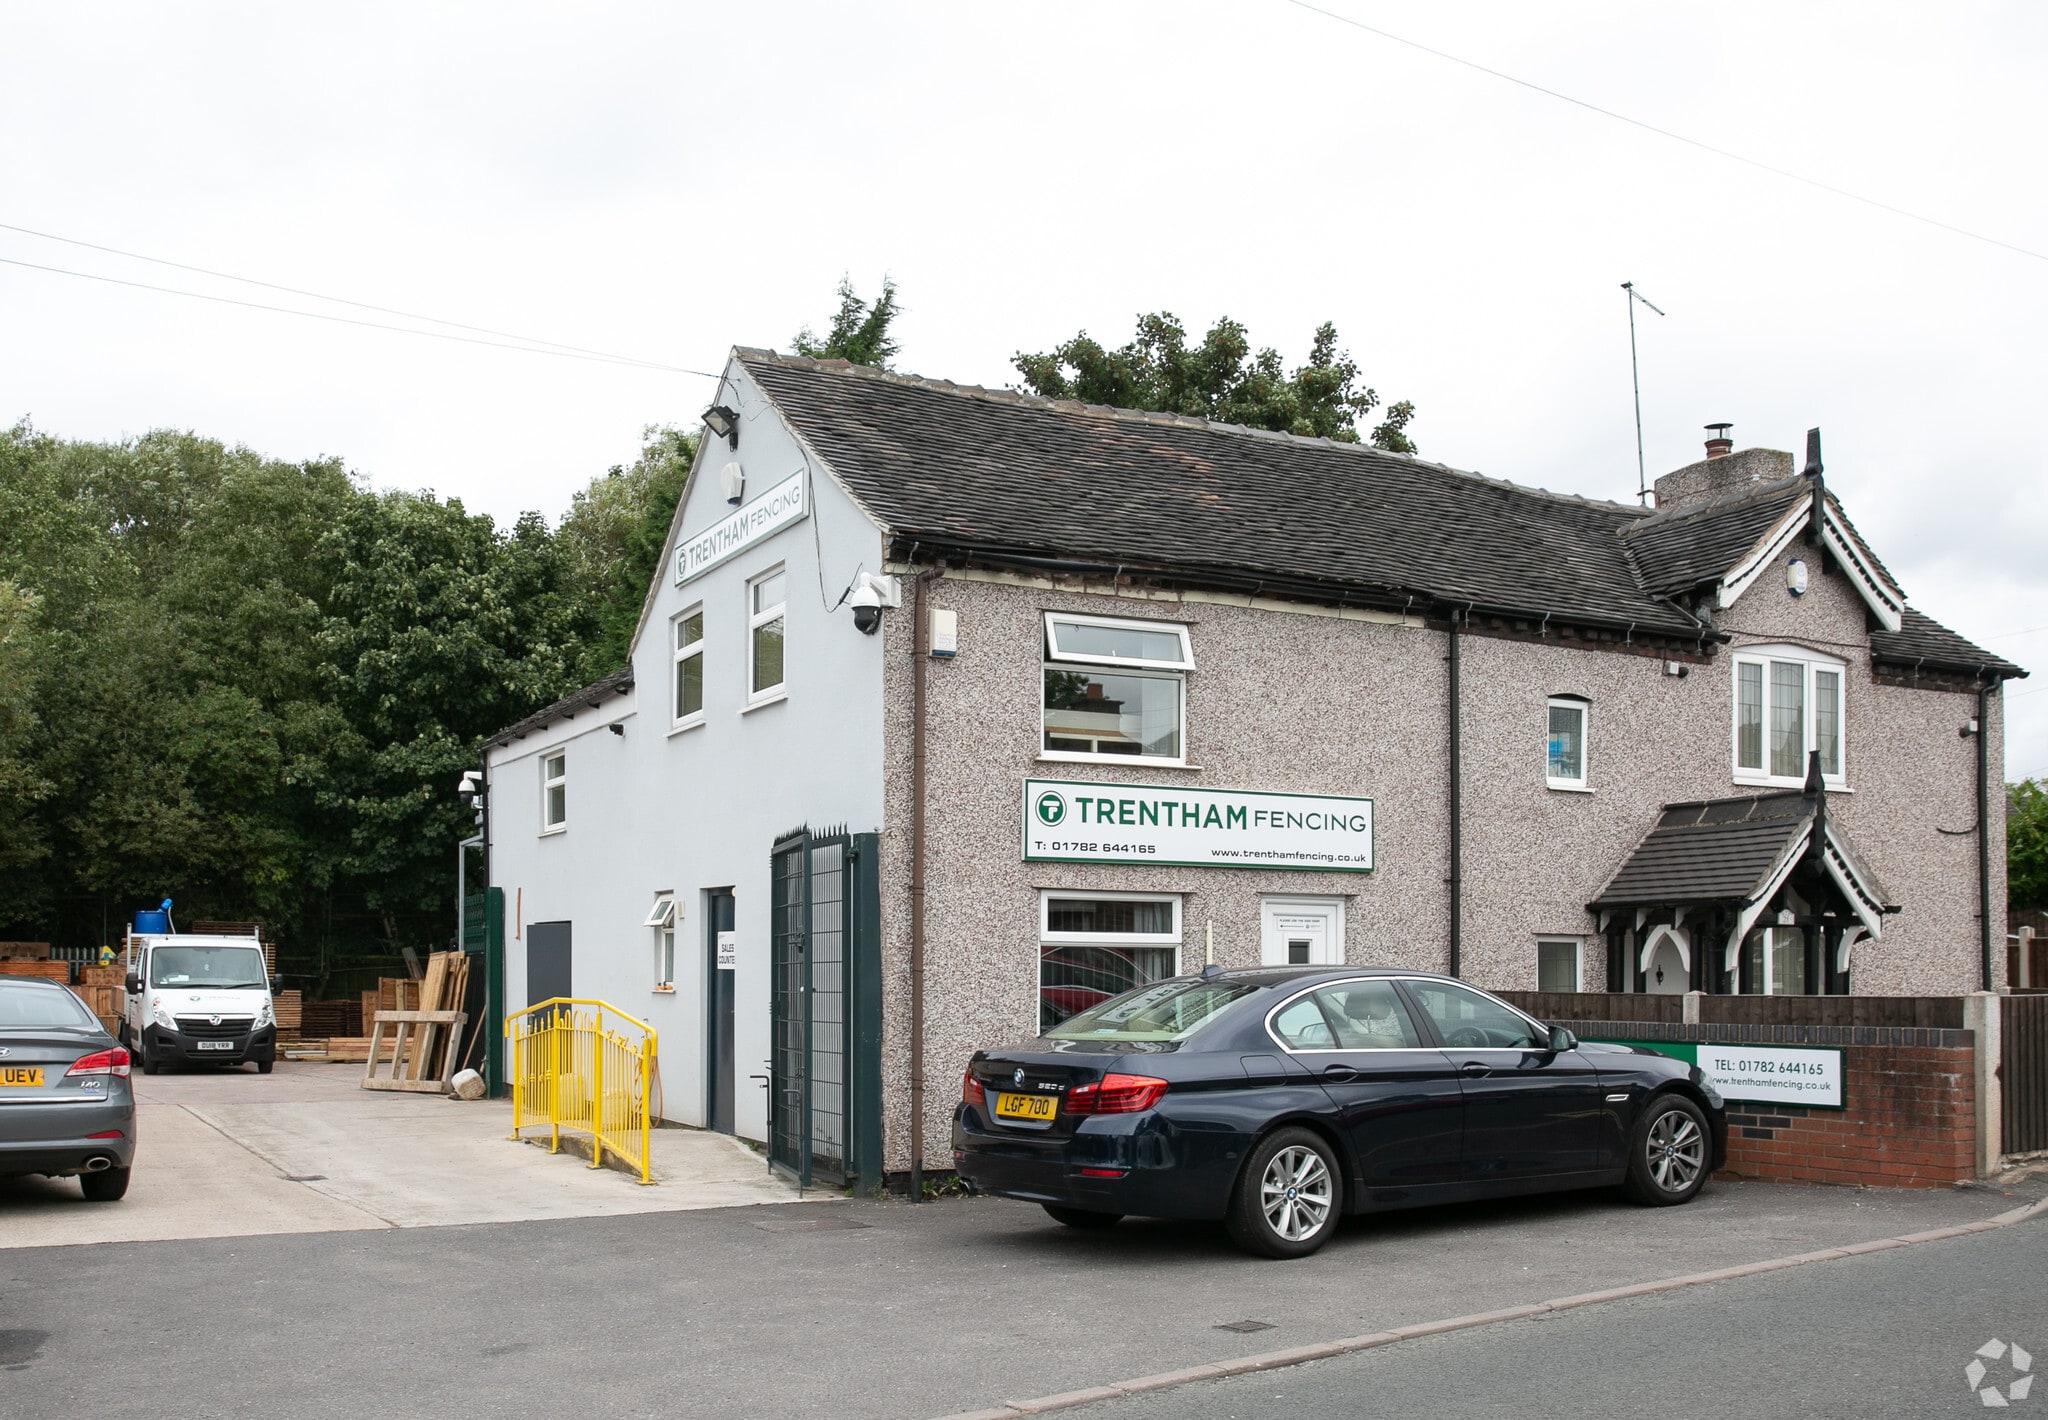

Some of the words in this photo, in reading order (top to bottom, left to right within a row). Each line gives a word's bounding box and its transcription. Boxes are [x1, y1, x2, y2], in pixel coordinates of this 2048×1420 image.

[689, 513, 749, 569] TRENTHAM
[750, 486, 800, 530] FENCING
[1075, 797, 1247, 830] TRENTHAM
[1255, 810, 1367, 832] FENCING
[1035, 841, 1047, 850] T:
[1052, 841, 1098, 852] 01782
[1102, 843, 1156, 854] 644165
[1211, 849, 1366, 863] www.trenthamfencing.co.uk
[721, 943, 735, 953] SALES
[1715, 1059, 1736, 1071] TEL:
[1739, 1060, 1775, 1073] 01782
[1779, 1062, 1824, 1075] 644165
[1004, 1095, 1026, 1113] LGF
[1028, 1097, 1050, 1115] 700
